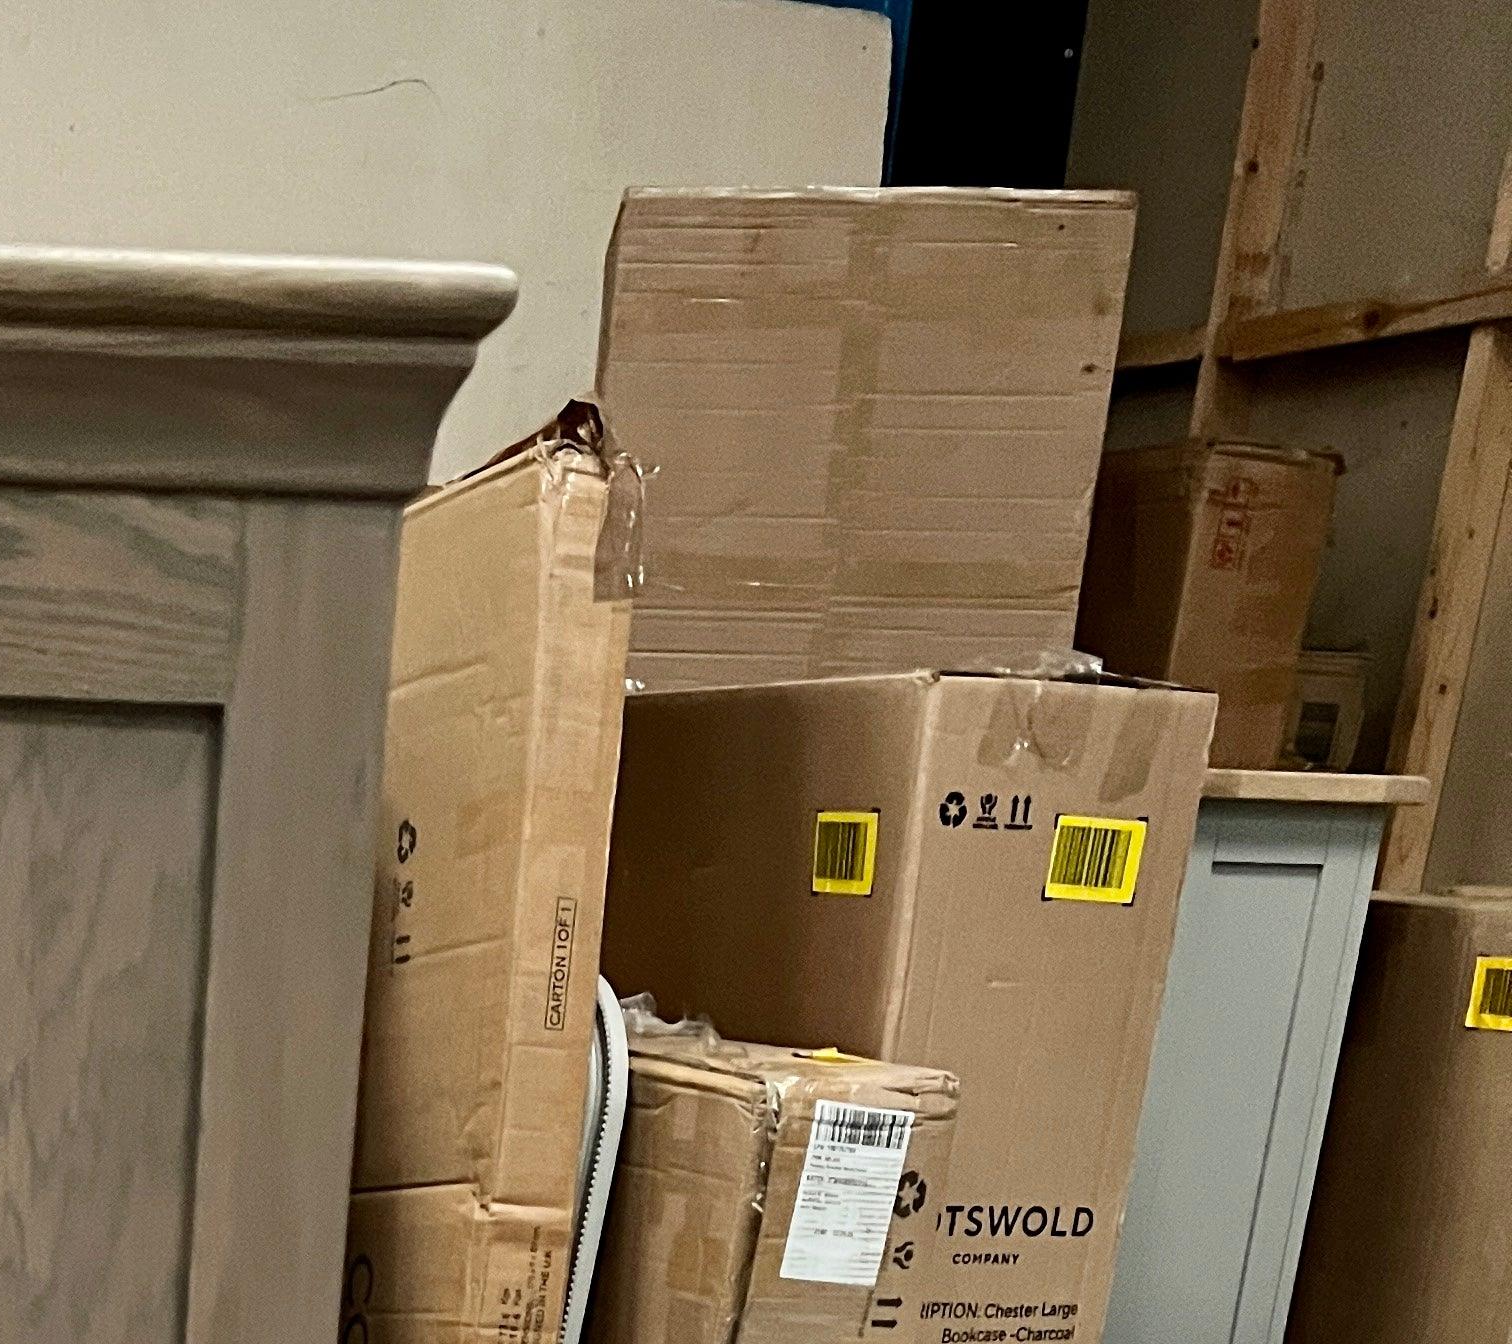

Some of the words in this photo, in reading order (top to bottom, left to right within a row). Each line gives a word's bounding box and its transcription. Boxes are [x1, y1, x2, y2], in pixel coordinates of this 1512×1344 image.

[557, 917, 570, 941] OF
[549, 956, 567, 1026] CARTON
[935, 1205, 1095, 1237] TSWOLD
[952, 1252, 1020, 1265] COMPANY
[539, 1271, 550, 1292] THE
[984, 1302, 1039, 1319] Chester
[1042, 1301, 1078, 1319] Large
[942, 1327, 1007, 1344] Bookcase
